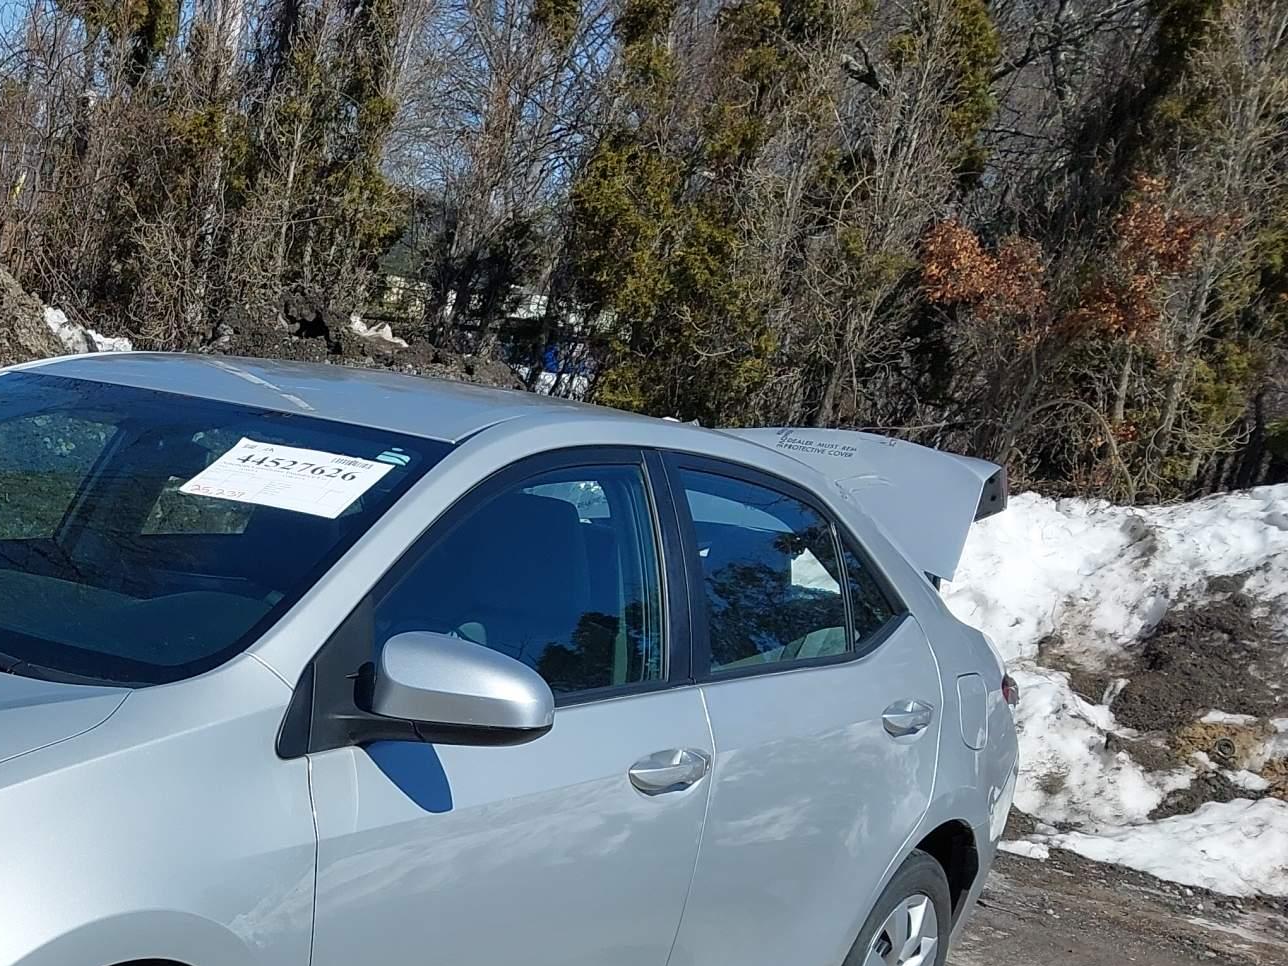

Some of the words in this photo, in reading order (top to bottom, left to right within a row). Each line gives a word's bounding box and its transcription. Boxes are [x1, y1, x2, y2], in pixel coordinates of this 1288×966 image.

[783, 443, 825, 455] PROTECTIVE
[828, 449, 853, 457] COVER
[787, 437, 813, 446] DEALER
[817, 442, 838, 450] MUST
[237, 454, 359, 481] 44527626
